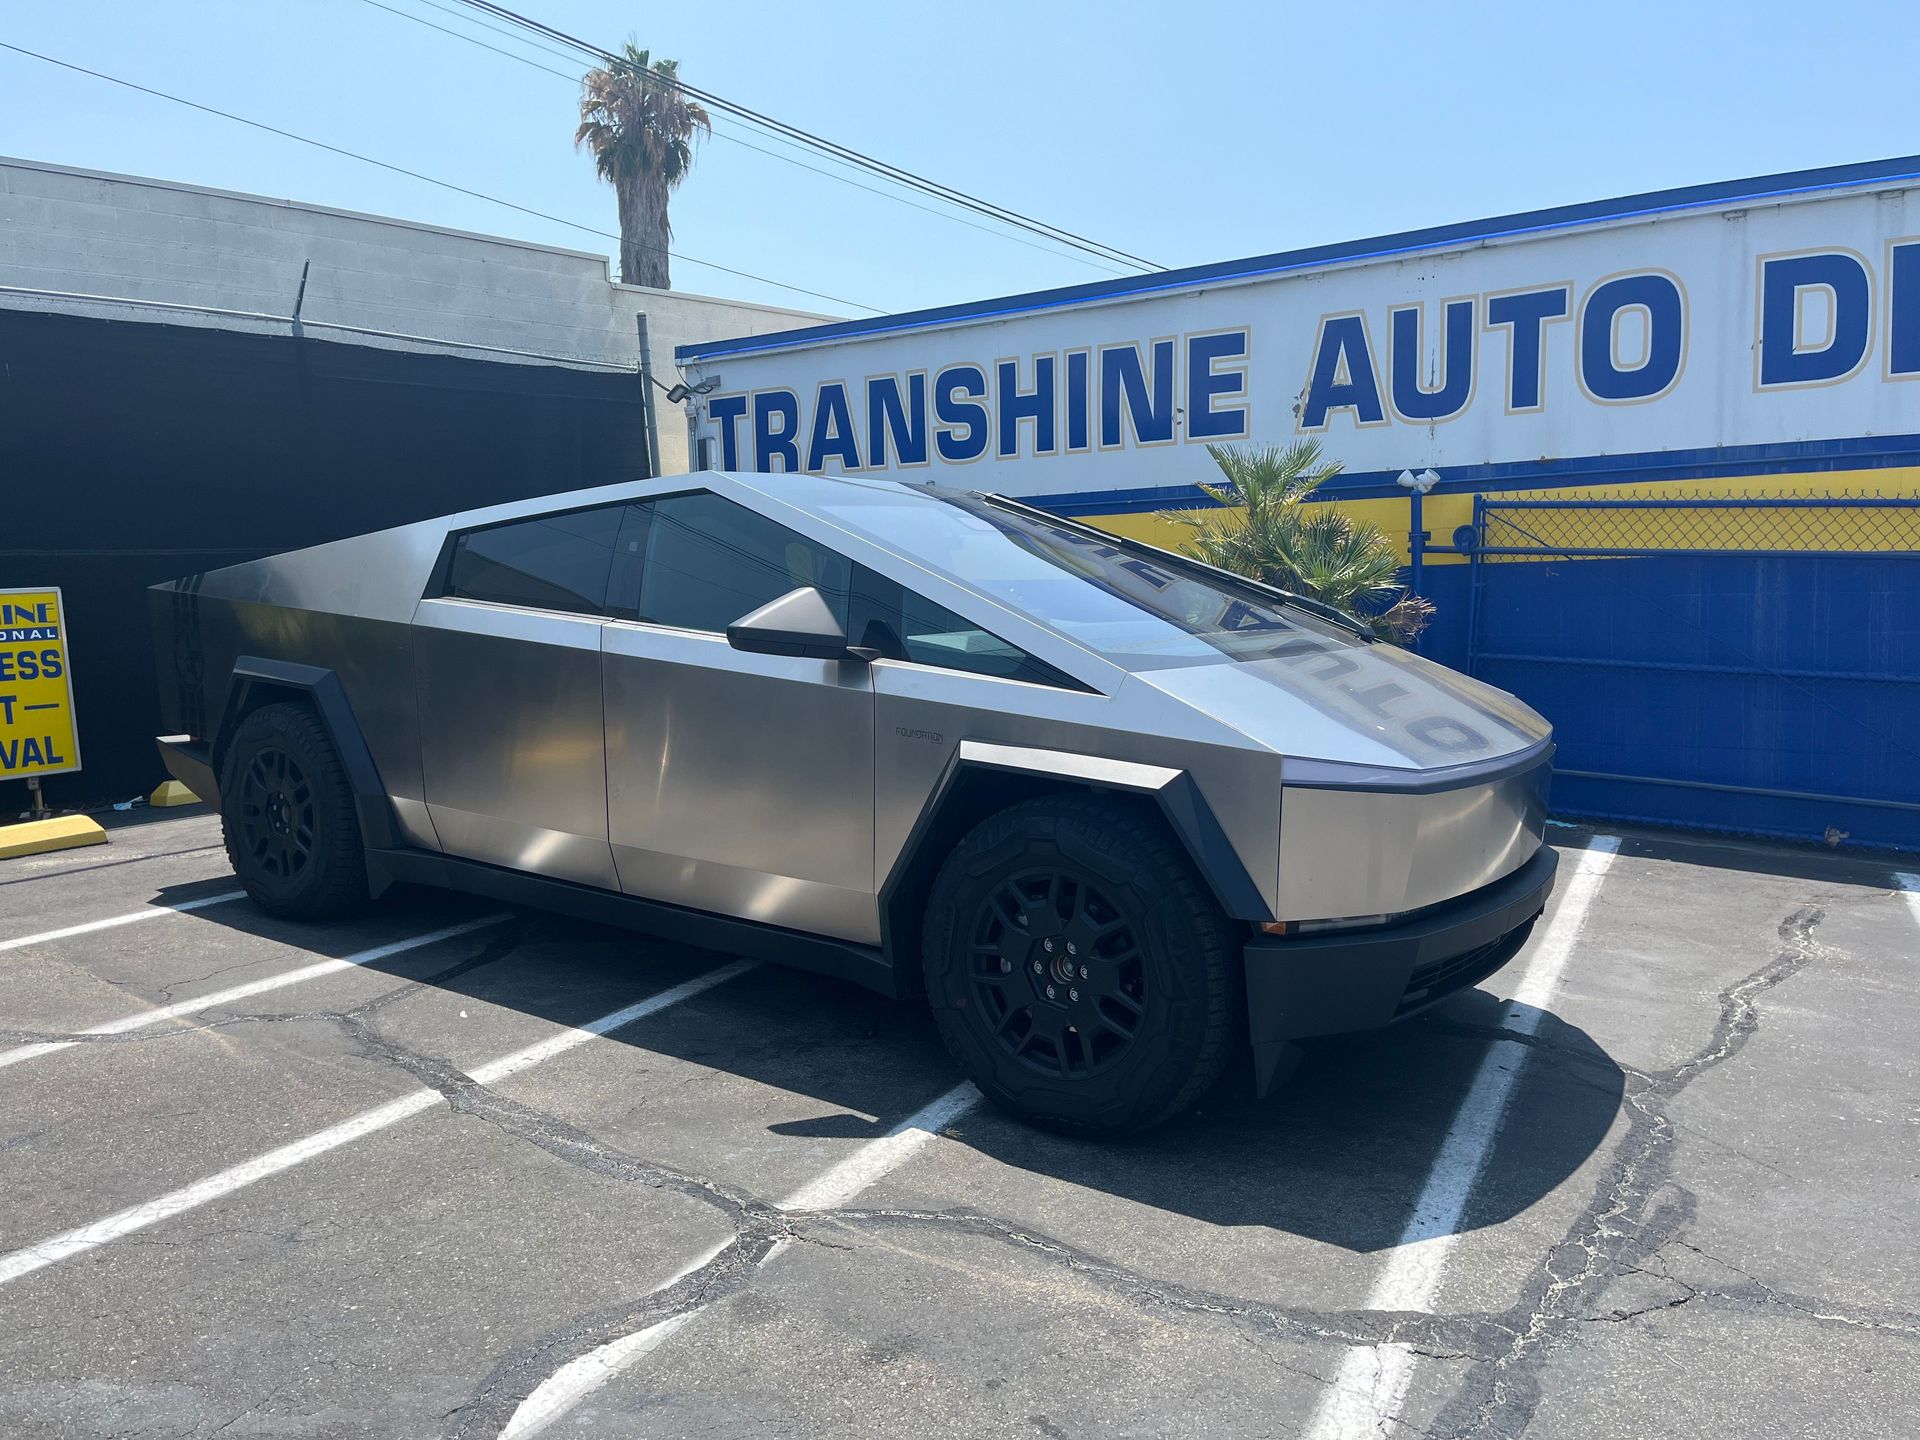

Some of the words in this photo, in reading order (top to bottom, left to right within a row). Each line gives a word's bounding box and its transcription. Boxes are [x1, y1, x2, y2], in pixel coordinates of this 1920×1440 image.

[706, 327, 1249, 475] TRANSHINE
[1299, 269, 1686, 431] AUTO
[0, 602, 56, 625] INE
[0, 649, 62, 681] ESS
[895, 727, 944, 743] FOUNDATION
[0, 736, 64, 769] VAL
